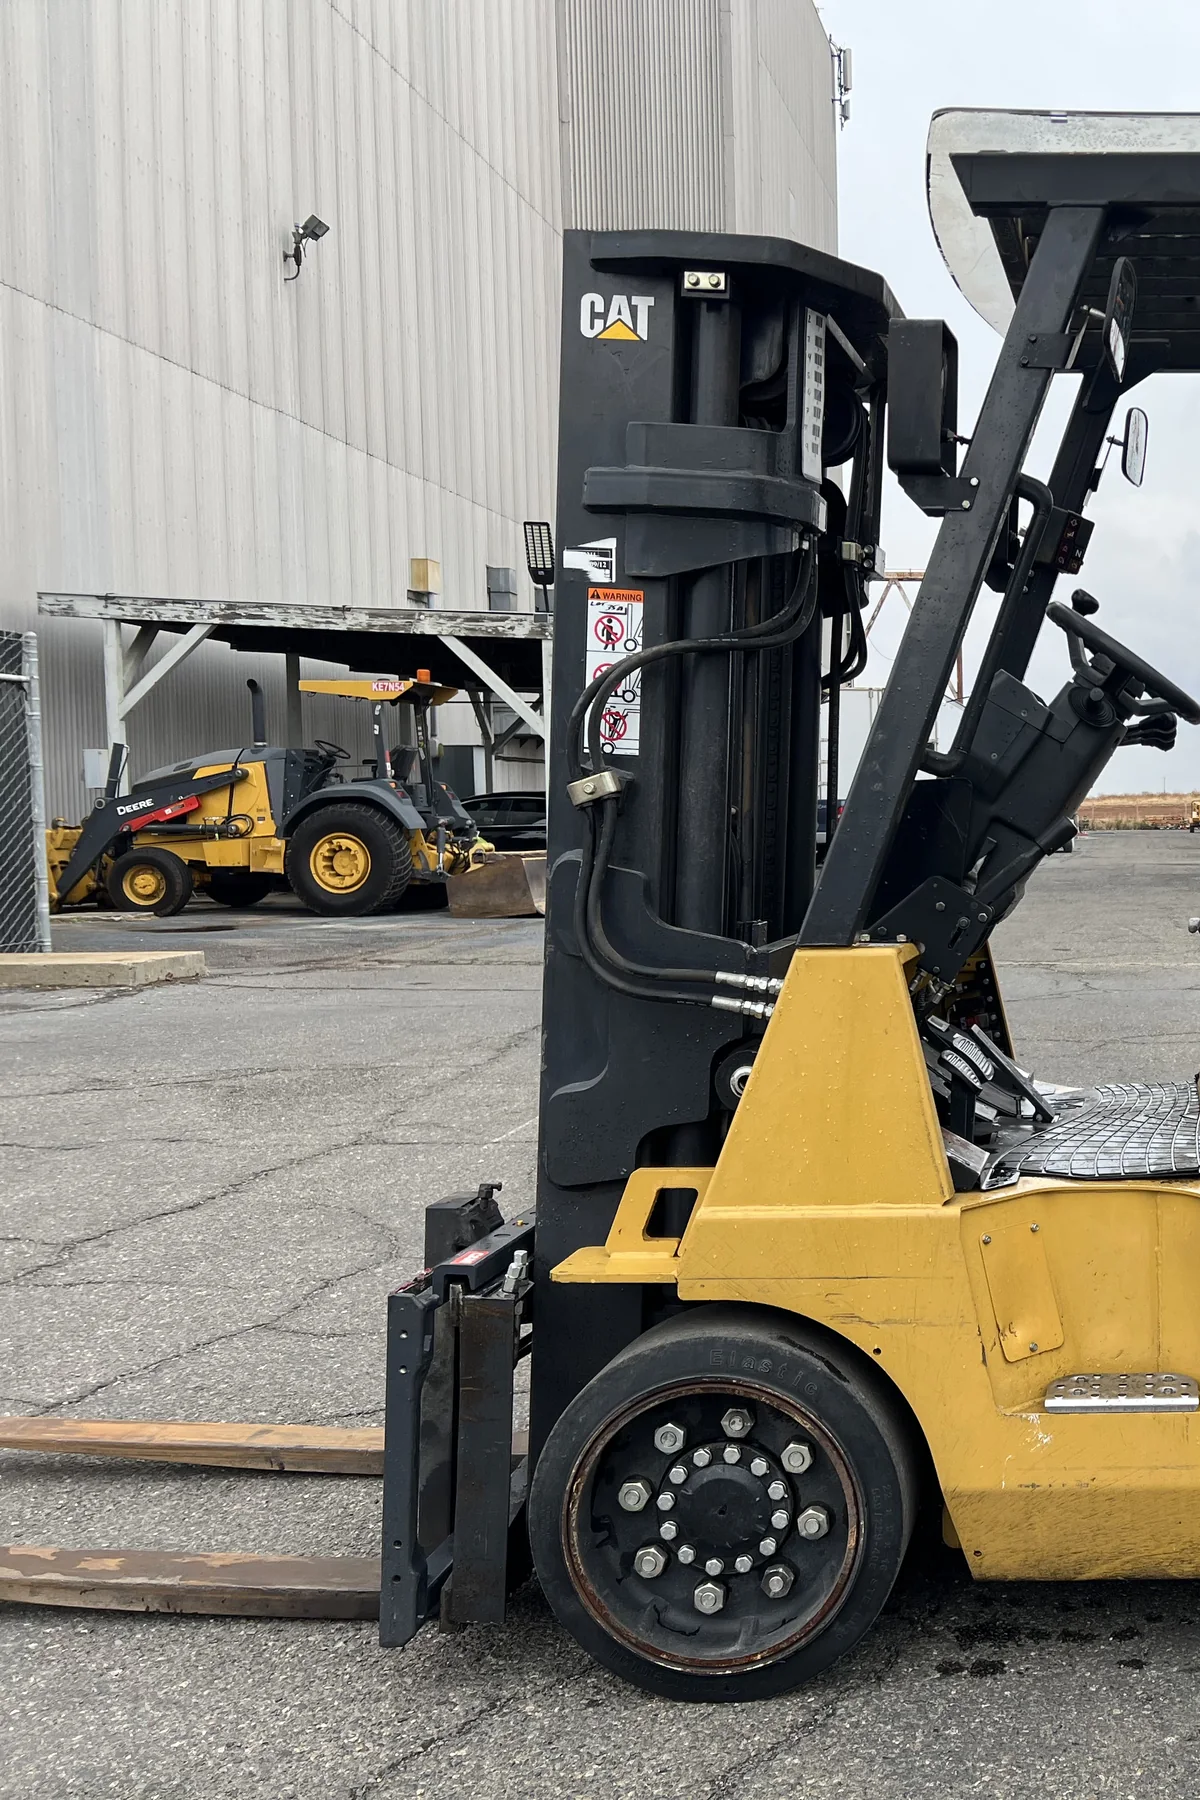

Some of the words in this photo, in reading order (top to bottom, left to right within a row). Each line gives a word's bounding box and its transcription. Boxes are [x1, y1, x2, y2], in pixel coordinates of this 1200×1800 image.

[580, 292, 655, 341] CAT
[603, 592, 642, 602] WARNING
[372, 682, 405, 692] KE7N54
[116, 798, 155, 817] DEERE
[708, 1347, 819, 1396] Elastic
